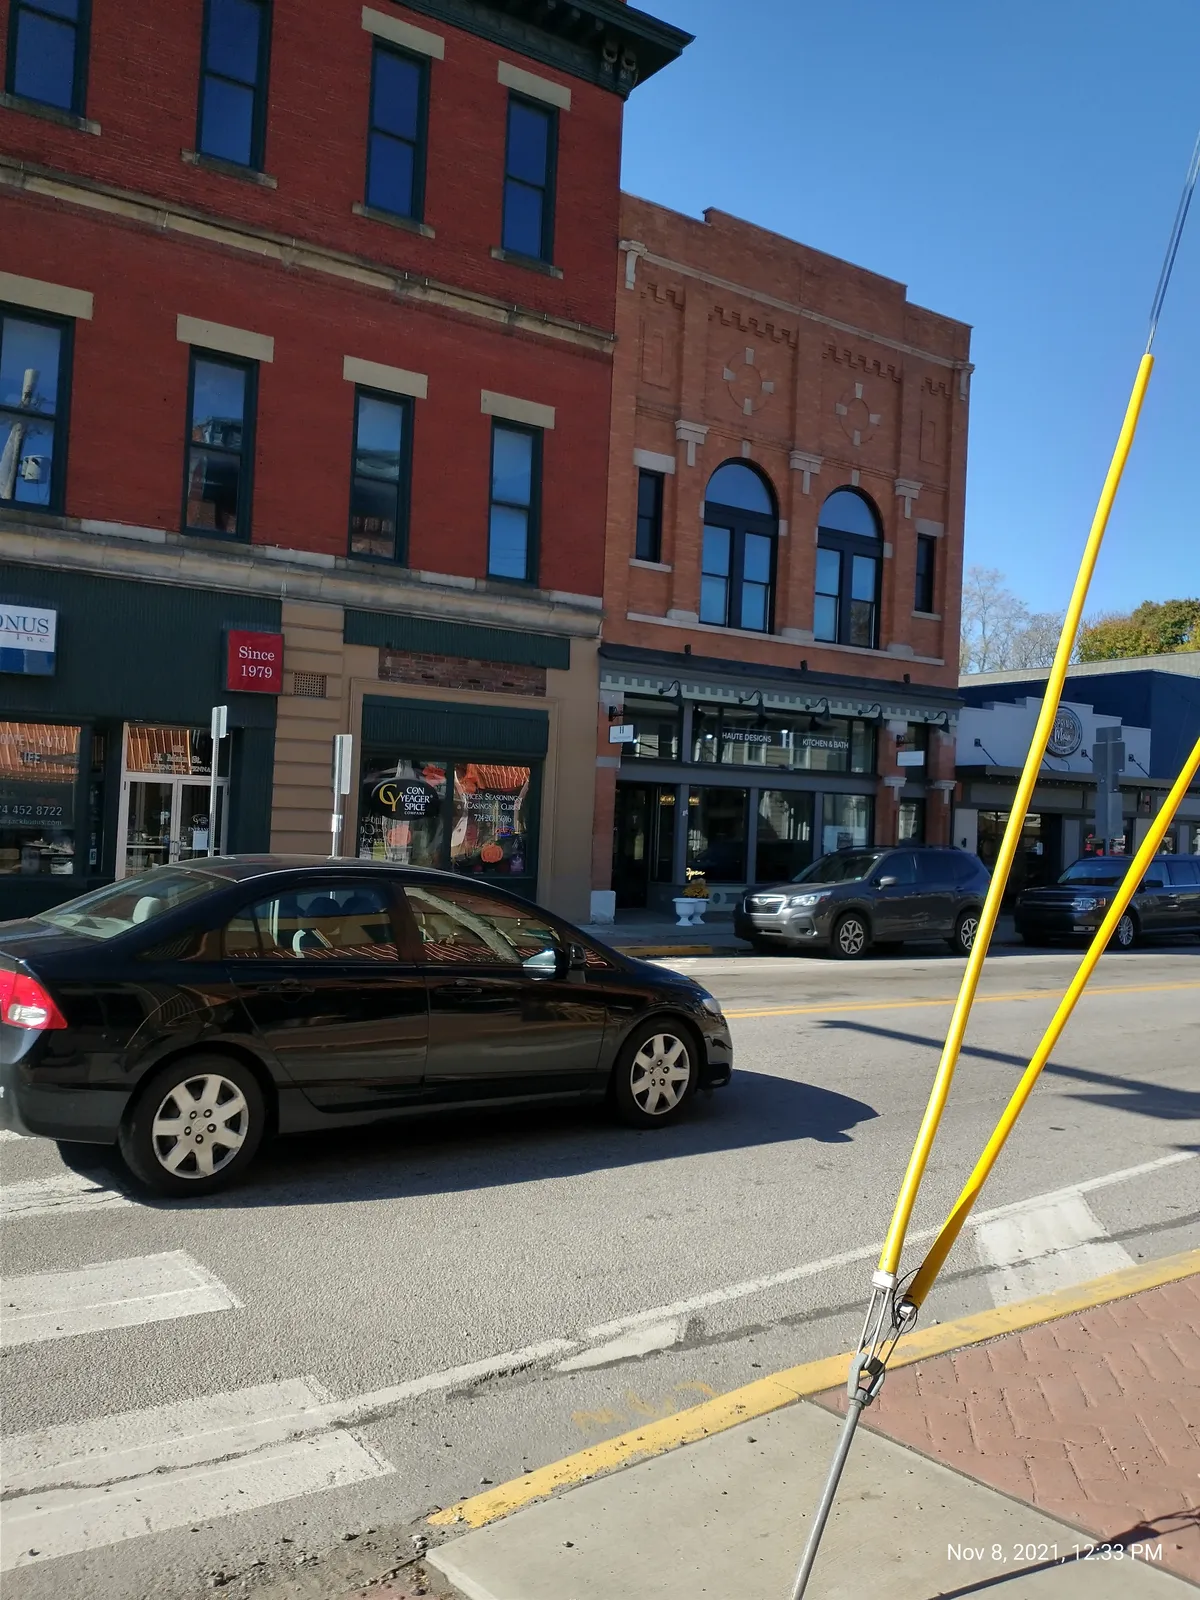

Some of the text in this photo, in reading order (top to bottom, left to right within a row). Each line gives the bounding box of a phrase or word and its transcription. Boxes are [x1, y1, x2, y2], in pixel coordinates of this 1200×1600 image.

[0, 614, 49, 634] NUS
[239, 646, 275, 661] Since
[241, 665, 273, 678] 1979
[722, 732, 743, 740] HAUTE
[744, 733, 772, 743] DESIGNS
[802, 739, 828, 747] KITCHEN
[834, 740, 849, 749] BATH
[406, 786, 425, 795] CON
[12, 805, 33, 815] 452
[36, 806, 63, 816] 8722
[404, 803, 426, 812] SPICE
